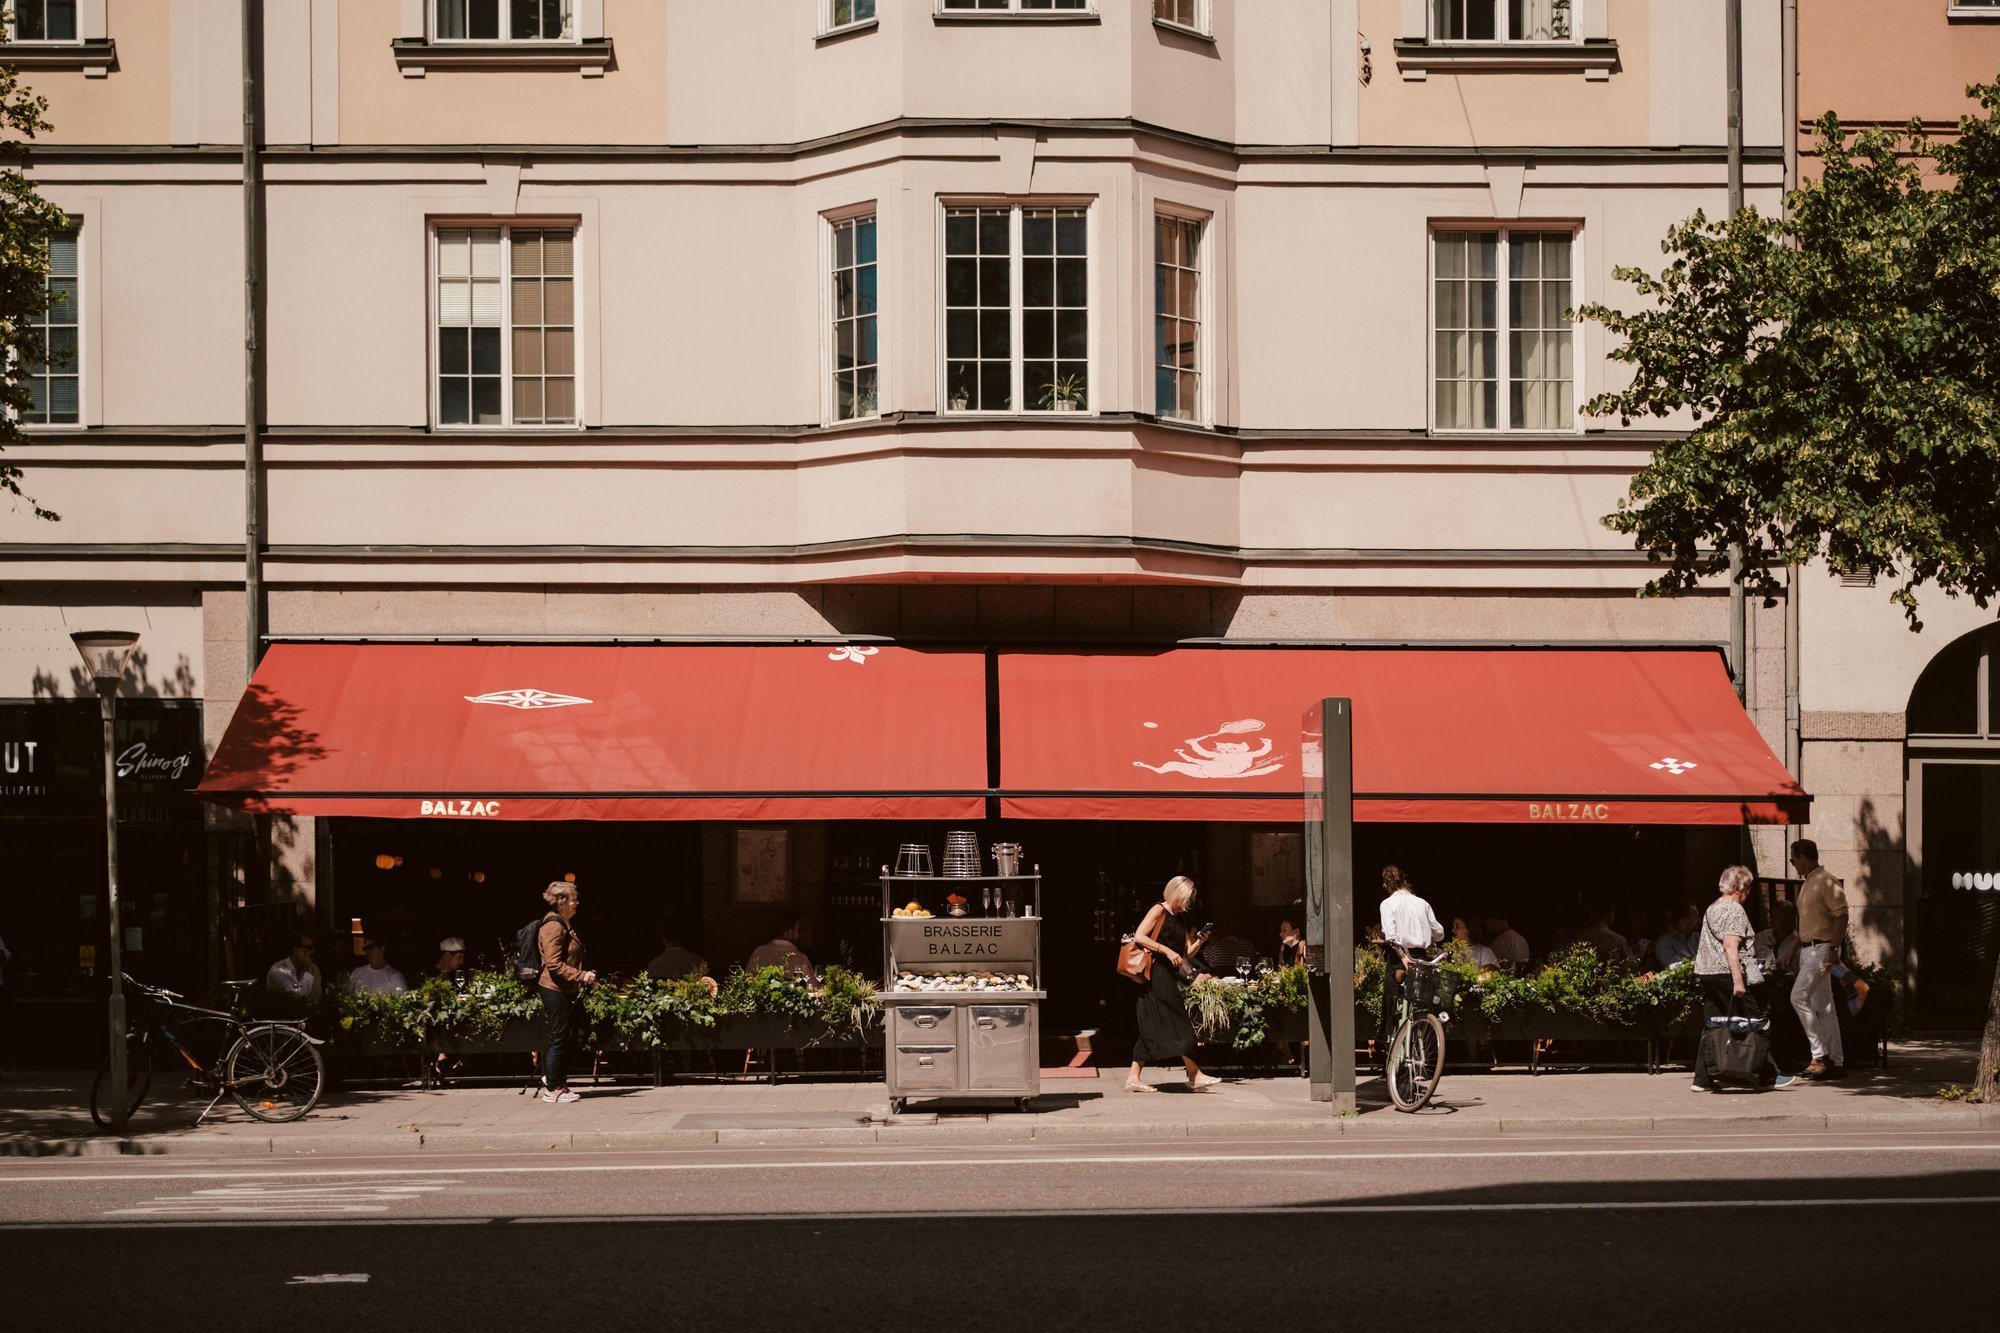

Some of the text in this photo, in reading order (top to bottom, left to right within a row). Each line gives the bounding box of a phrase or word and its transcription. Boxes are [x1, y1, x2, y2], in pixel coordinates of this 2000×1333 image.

[116, 742, 192, 780] Shinogi
[420, 800, 501, 817] BALZAC
[1529, 803, 1609, 820] BALZAC
[924, 926, 1002, 937] BRASSERIE
[929, 943, 998, 955] BALZAC
